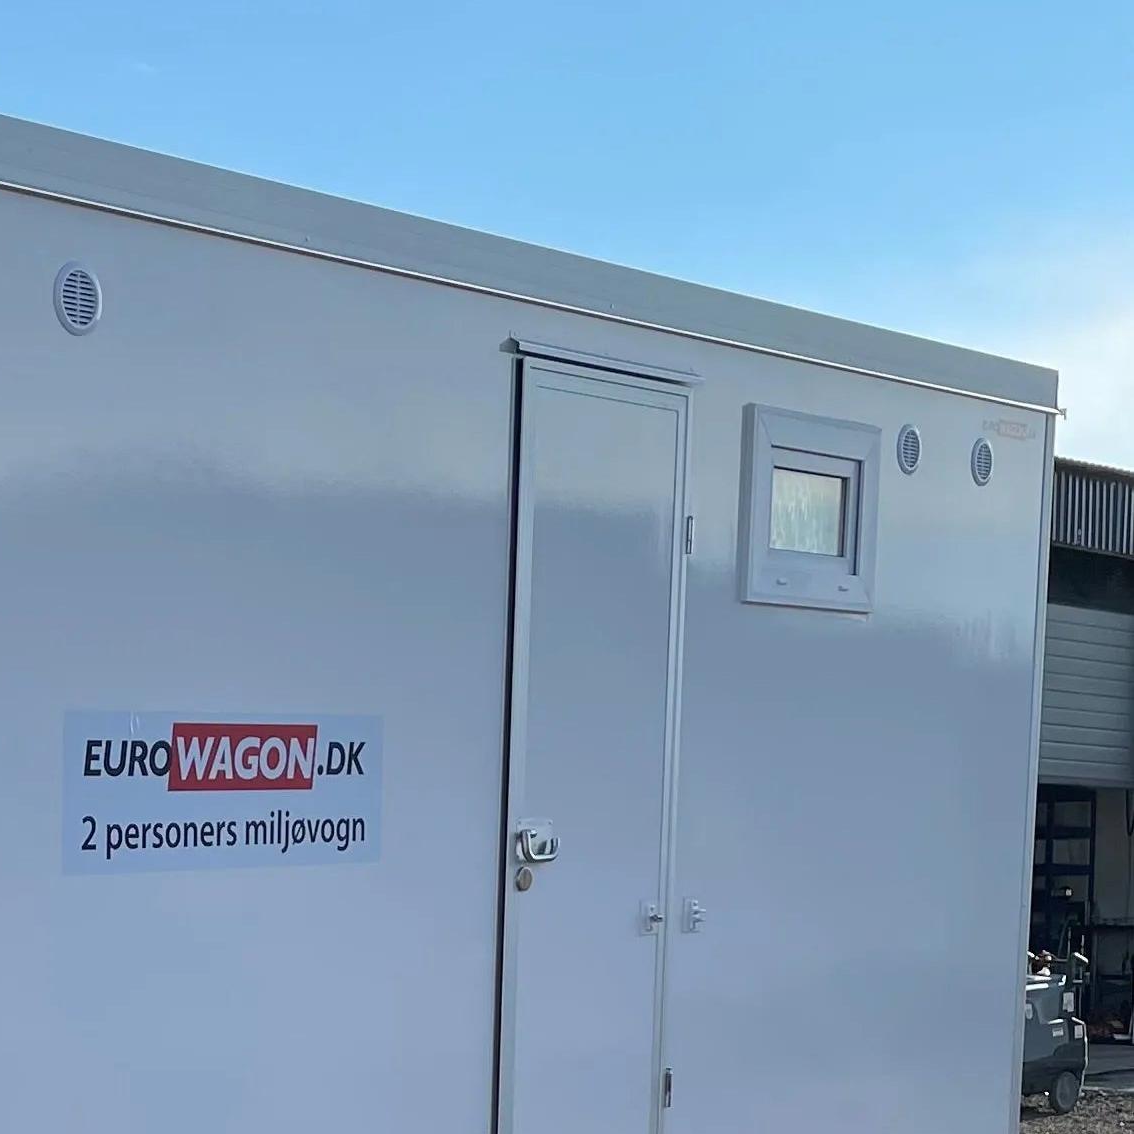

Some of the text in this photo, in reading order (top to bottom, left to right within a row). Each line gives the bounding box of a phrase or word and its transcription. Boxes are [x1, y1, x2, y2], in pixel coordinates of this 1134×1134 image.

[83, 736, 366, 781] EUROWAGON.DK
[81, 810, 365, 860] 2 personers miljøvogn
